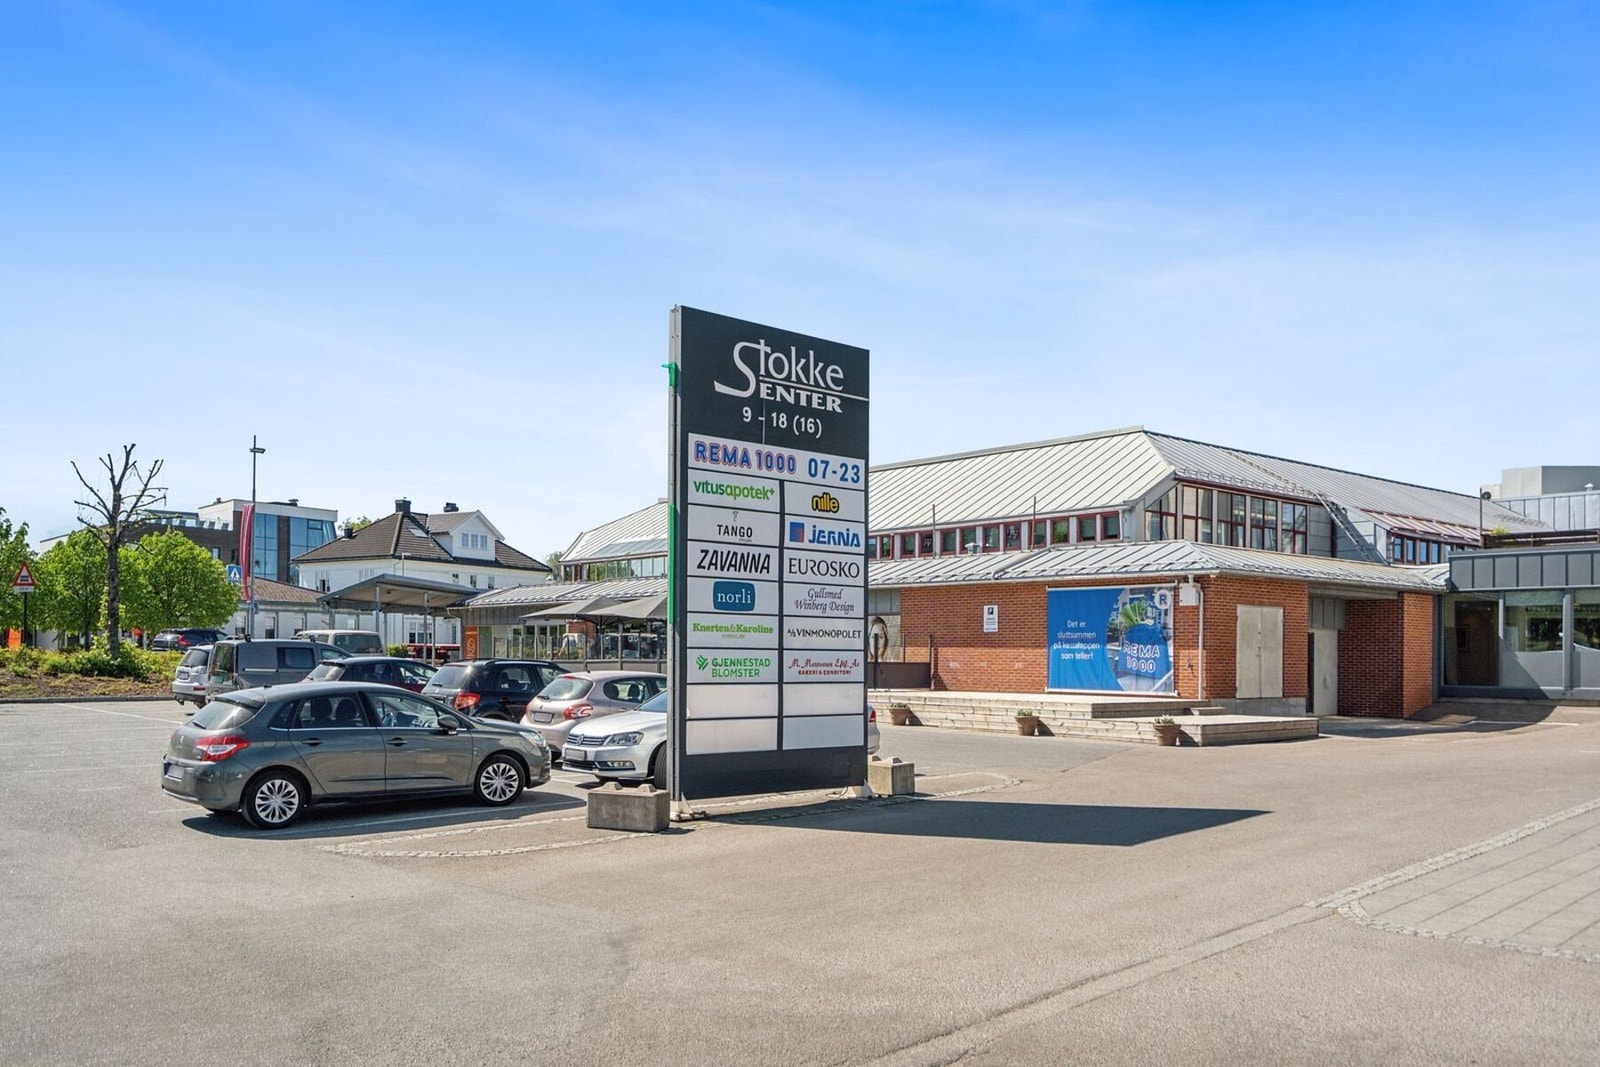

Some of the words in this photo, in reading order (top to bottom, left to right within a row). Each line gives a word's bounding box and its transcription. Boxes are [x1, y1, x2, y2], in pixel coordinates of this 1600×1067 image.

[714, 339, 843, 398] Stokke
[742, 406, 752, 423] 9
[771, 412, 788, 429] 18
[793, 415, 822, 439] (16)
[695, 440, 752, 468] REMA
[755, 449, 797, 475] 1000
[808, 457, 861, 484] 07-23
[811, 491, 840, 513] nille
[716, 524, 753, 538] TANGO
[696, 549, 771, 575] ZAVANNA
[788, 557, 860, 579] EUROSKO
[717, 588, 752, 604] norli
[807, 587, 844, 601] Gullsmed
[1160, 595, 1168, 605] R
[828, 601, 855, 615] Design
[1067, 620, 1078, 628] Det
[797, 629, 861, 639] VINMONOPOLET
[1053, 641, 1062, 650] på
[1124, 641, 1160, 658] REMA
[711, 657, 771, 668] GJENNESTAD
[1061, 652, 1075, 660] som
[1127, 656, 1156, 673] 1000
[711, 668, 760, 678] BLOMSTER
